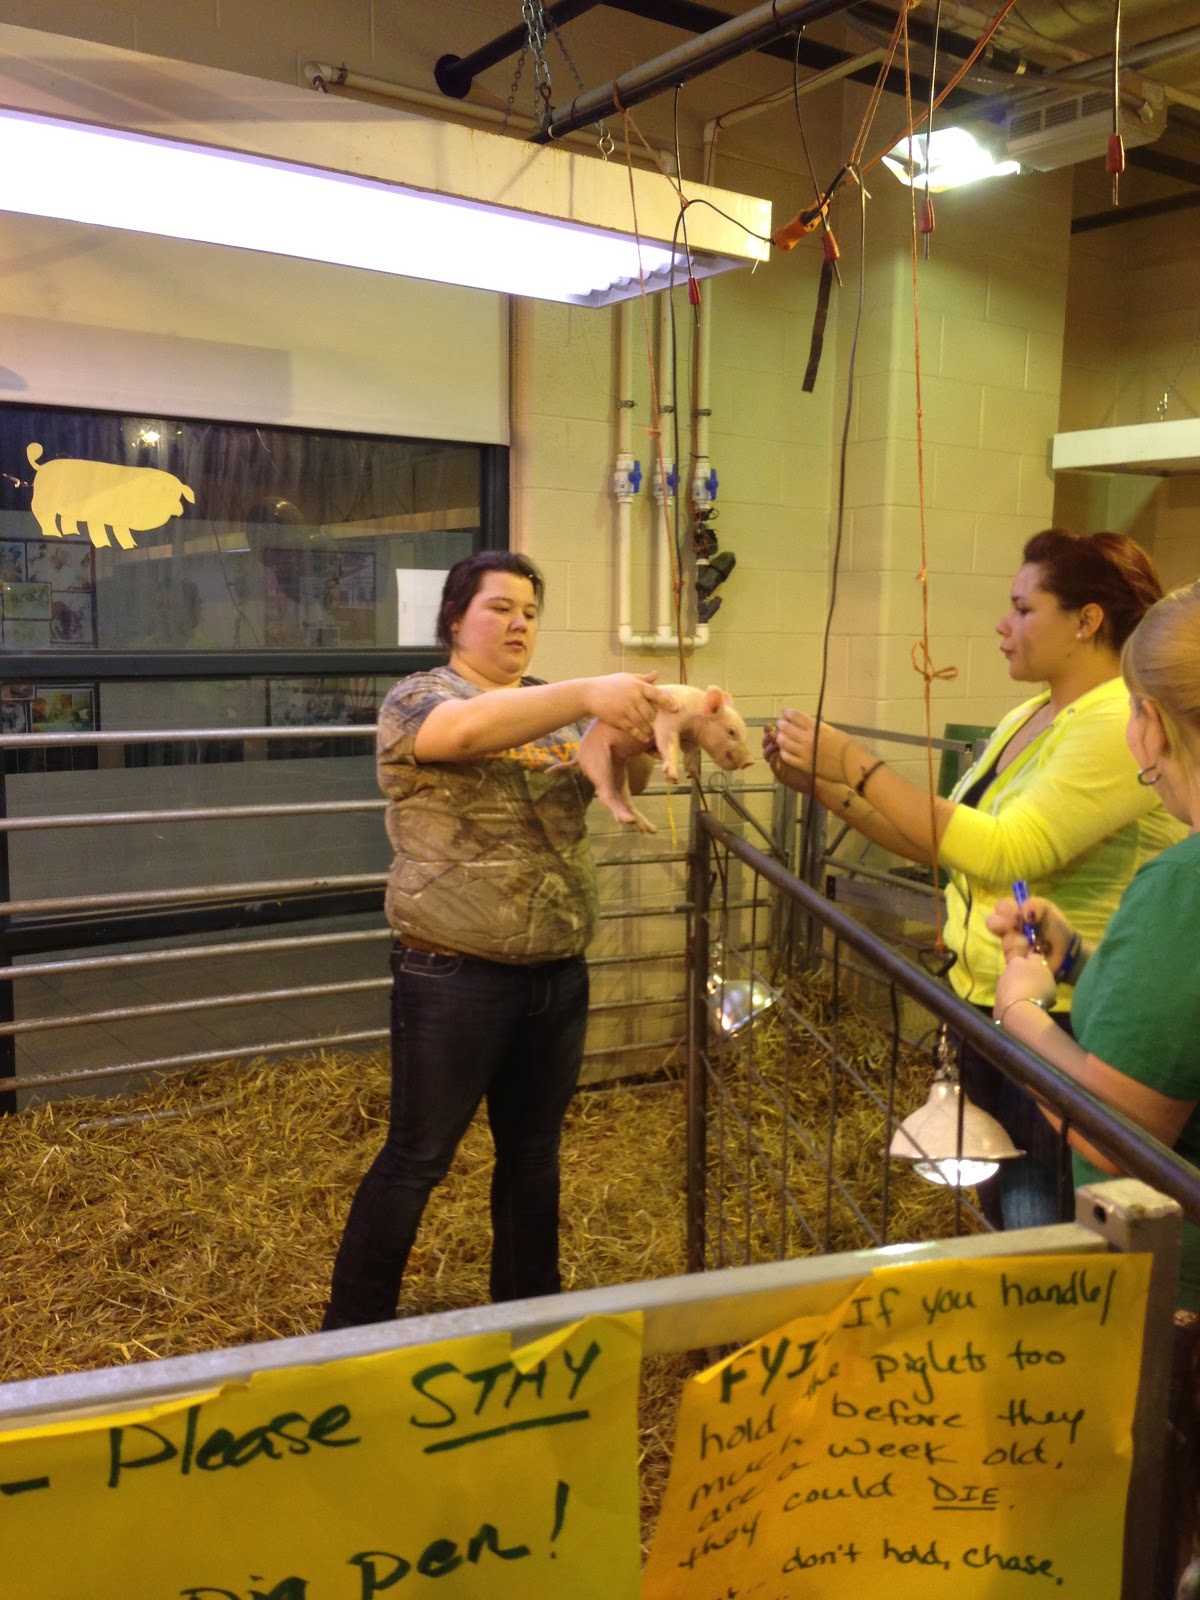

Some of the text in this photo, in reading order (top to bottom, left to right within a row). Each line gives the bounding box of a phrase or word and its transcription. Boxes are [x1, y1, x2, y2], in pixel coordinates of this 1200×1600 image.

[842, 1287, 901, 1329] If
[921, 1287, 978, 1326] you
[699, 1402, 777, 1461] hold
[1006, 1338, 1067, 1371] too
[831, 1392, 968, 1428] before
[996, 1397, 1086, 1445] they
[828, 1437, 958, 1467] week
[678, 1510, 763, 1571] they
[783, 1471, 896, 1512] could
[782, 1543, 862, 1574] don't
